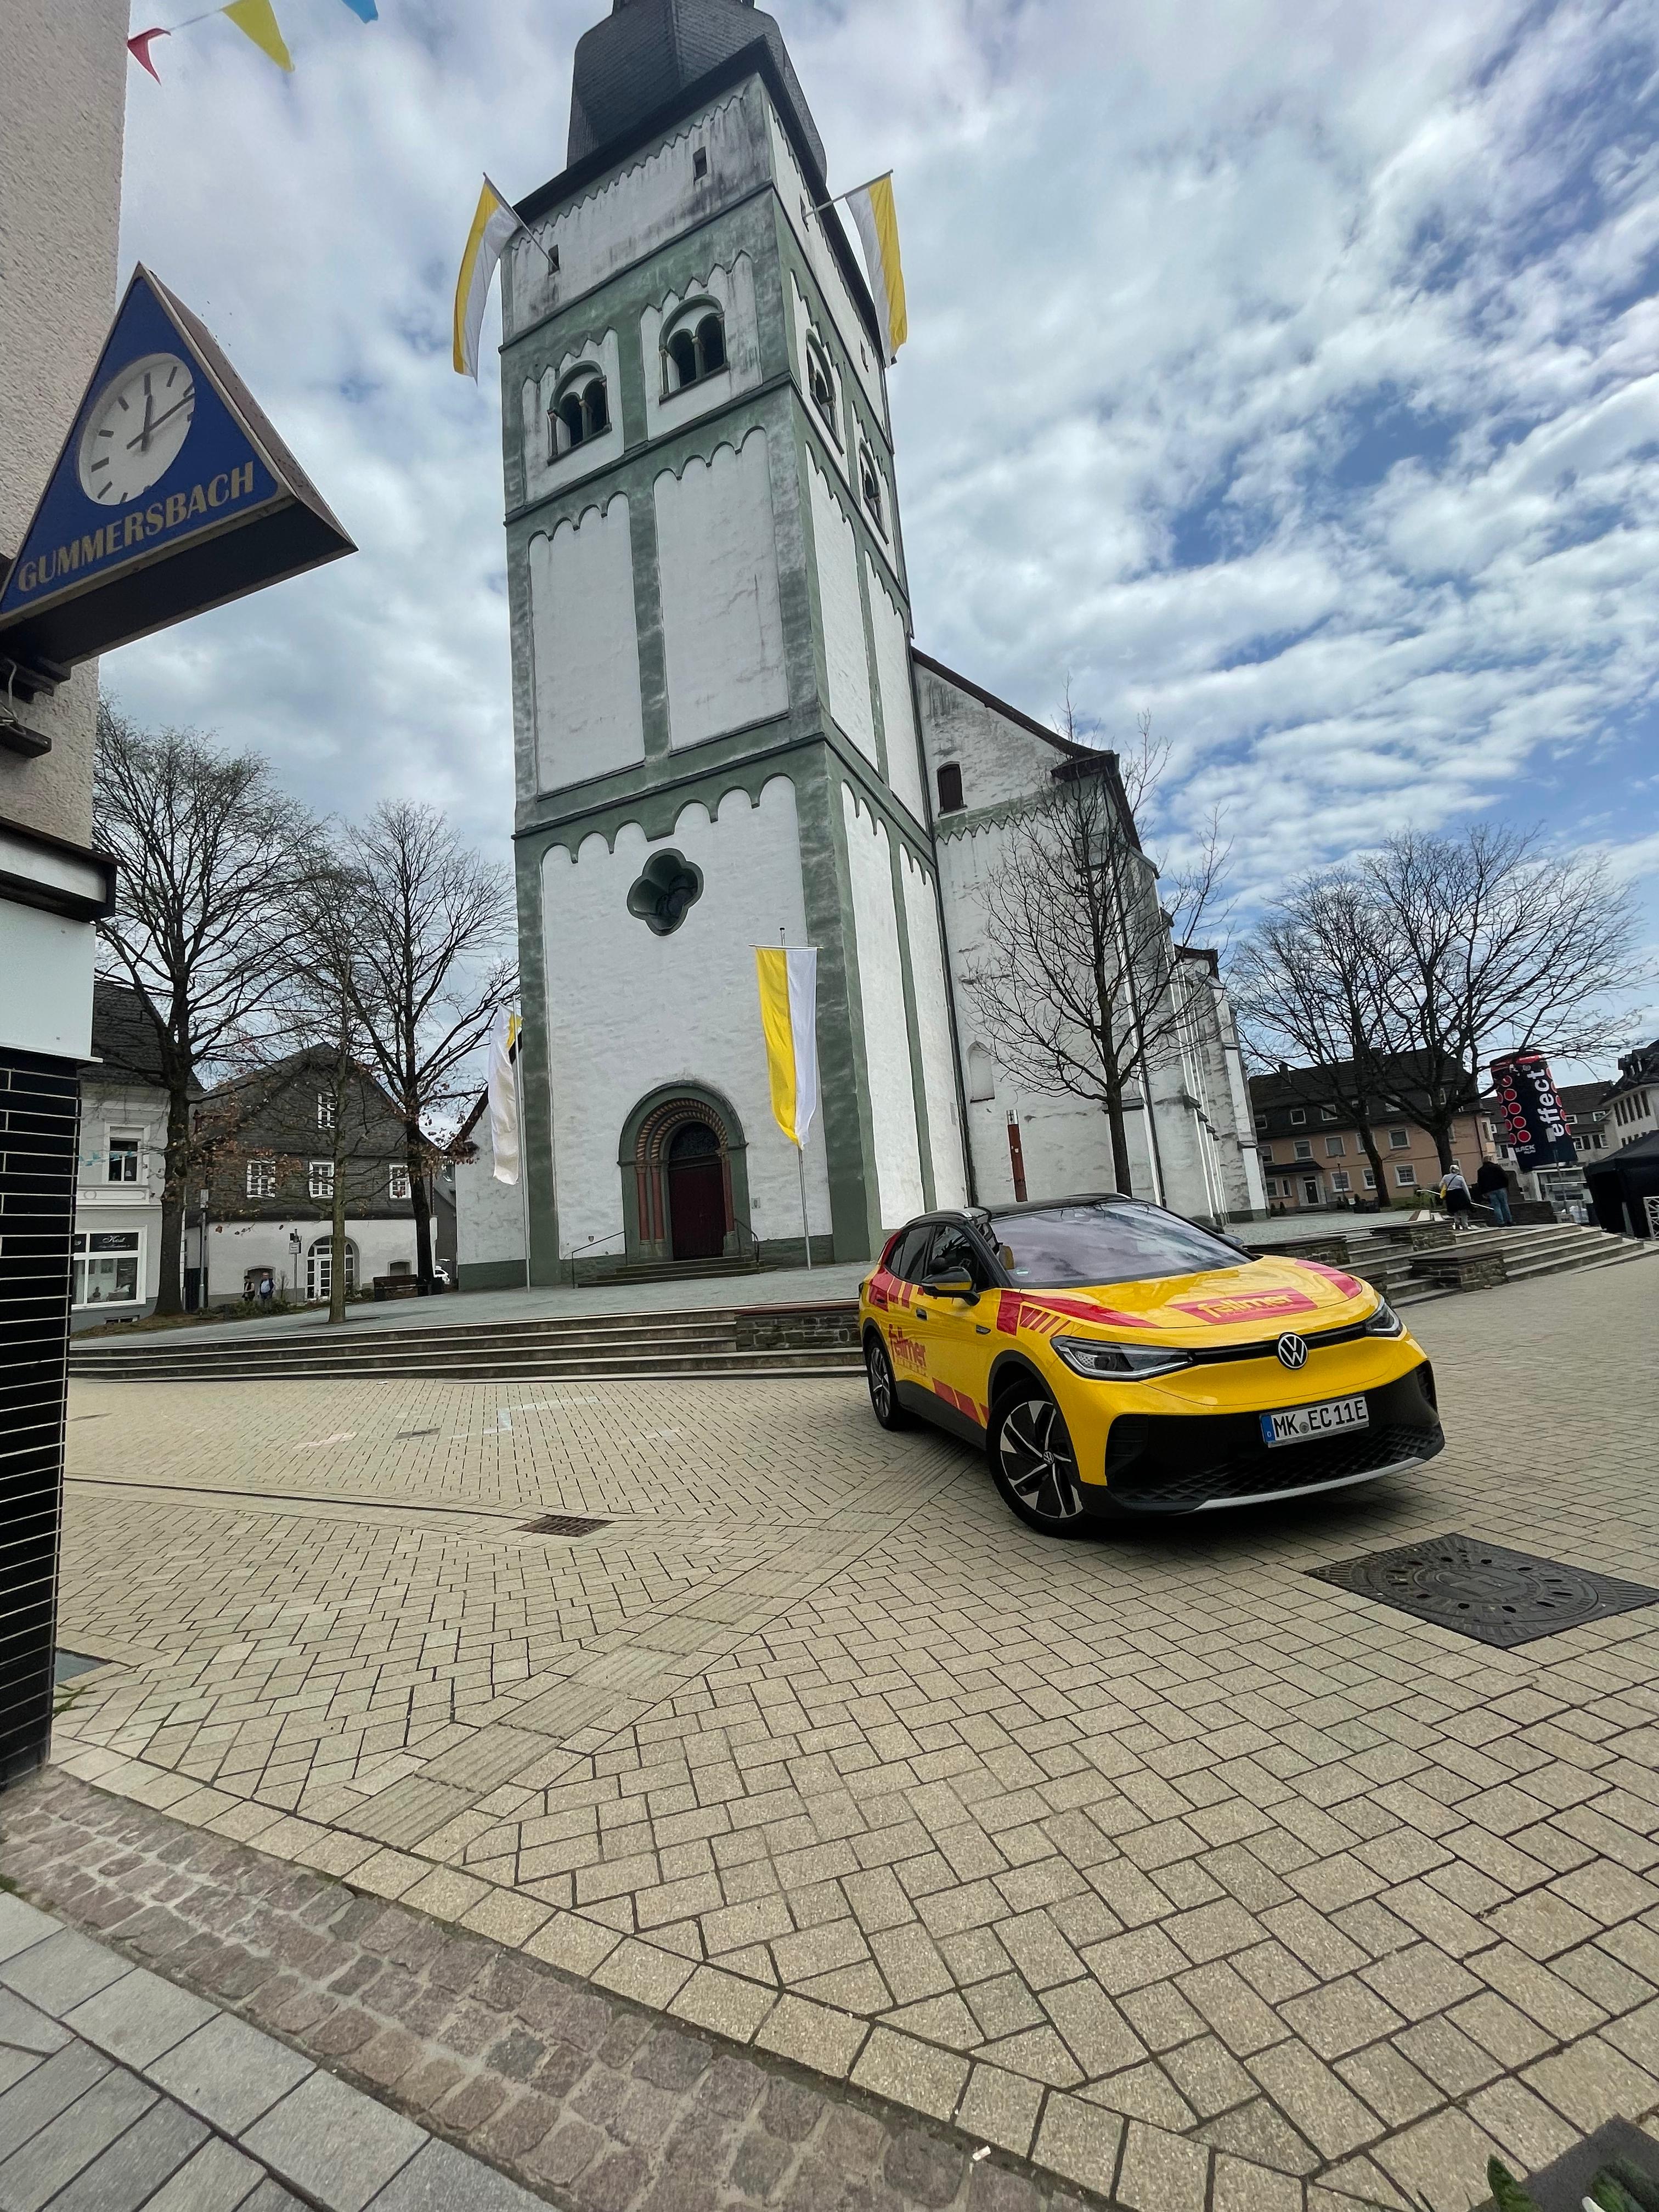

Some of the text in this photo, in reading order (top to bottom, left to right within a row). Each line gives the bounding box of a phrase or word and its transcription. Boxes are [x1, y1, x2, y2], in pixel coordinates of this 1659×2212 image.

[18, 461, 254, 592] GUMMERSBACH
[1527, 1069, 1565, 1137] effect
[1273, 1413, 1299, 1438] MK
